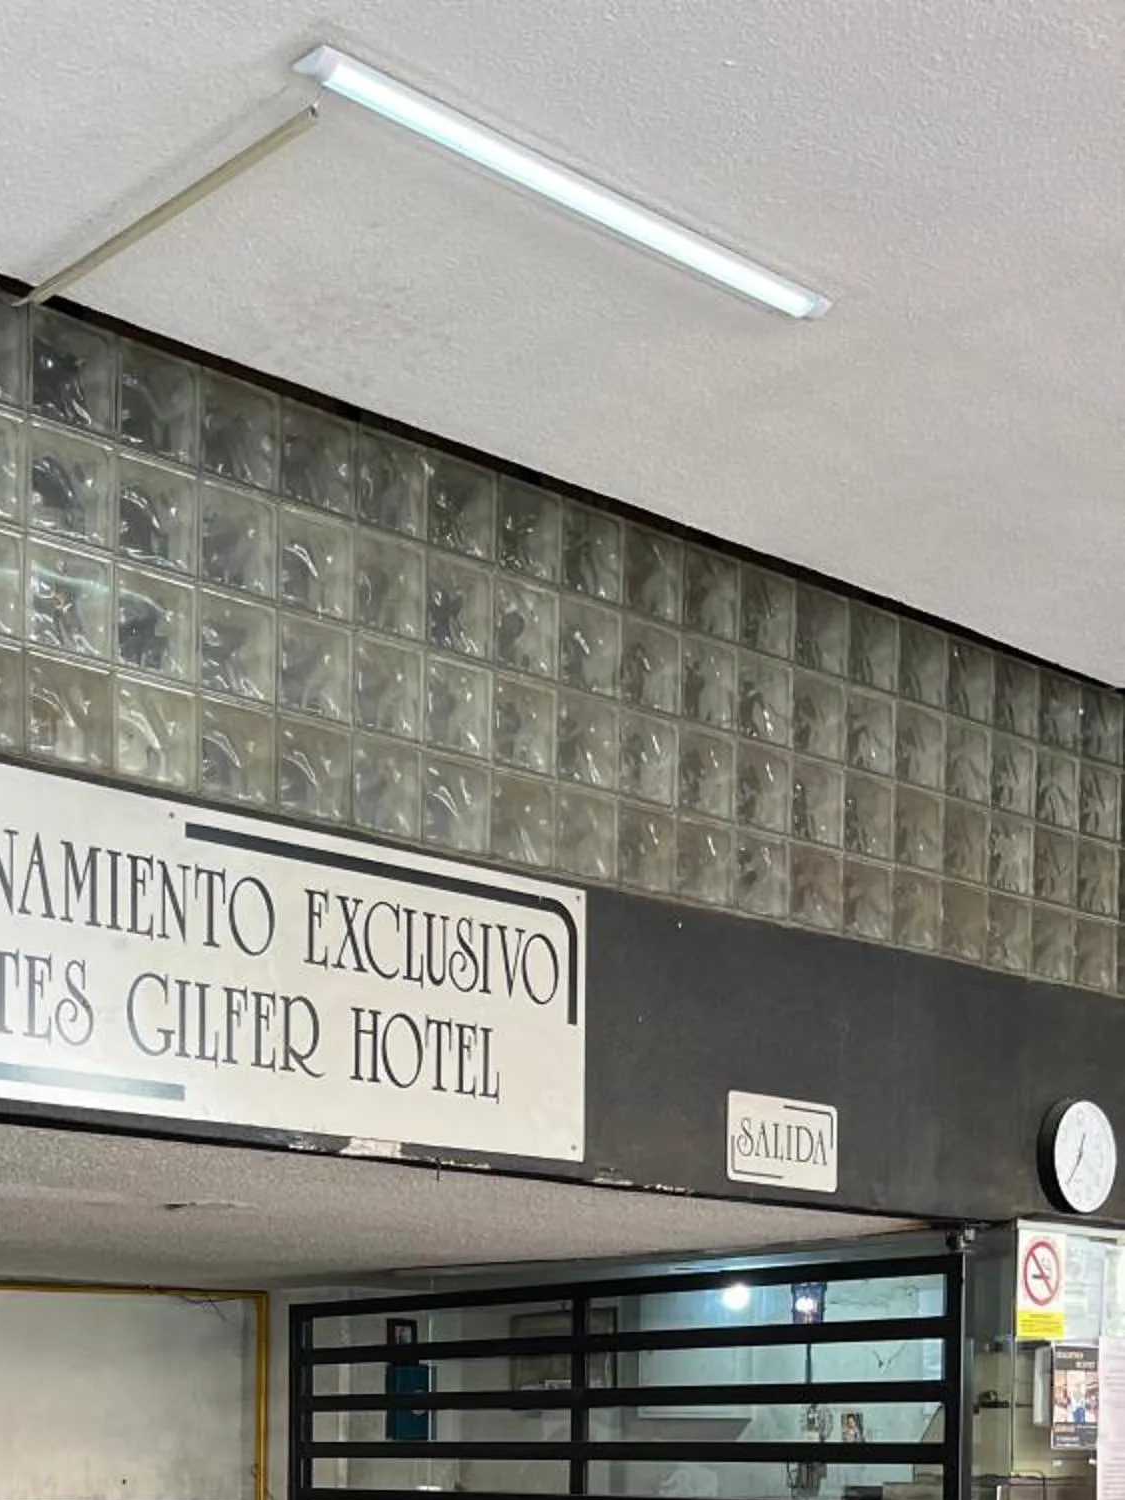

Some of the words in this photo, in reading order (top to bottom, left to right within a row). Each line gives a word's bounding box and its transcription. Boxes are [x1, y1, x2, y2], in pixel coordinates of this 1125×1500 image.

[303, 888, 560, 1006] EXCLUSIVO
[126, 973, 325, 1078] GILFER
[350, 1007, 499, 1104] HOTEL
[737, 1117, 828, 1166] SALIDA
